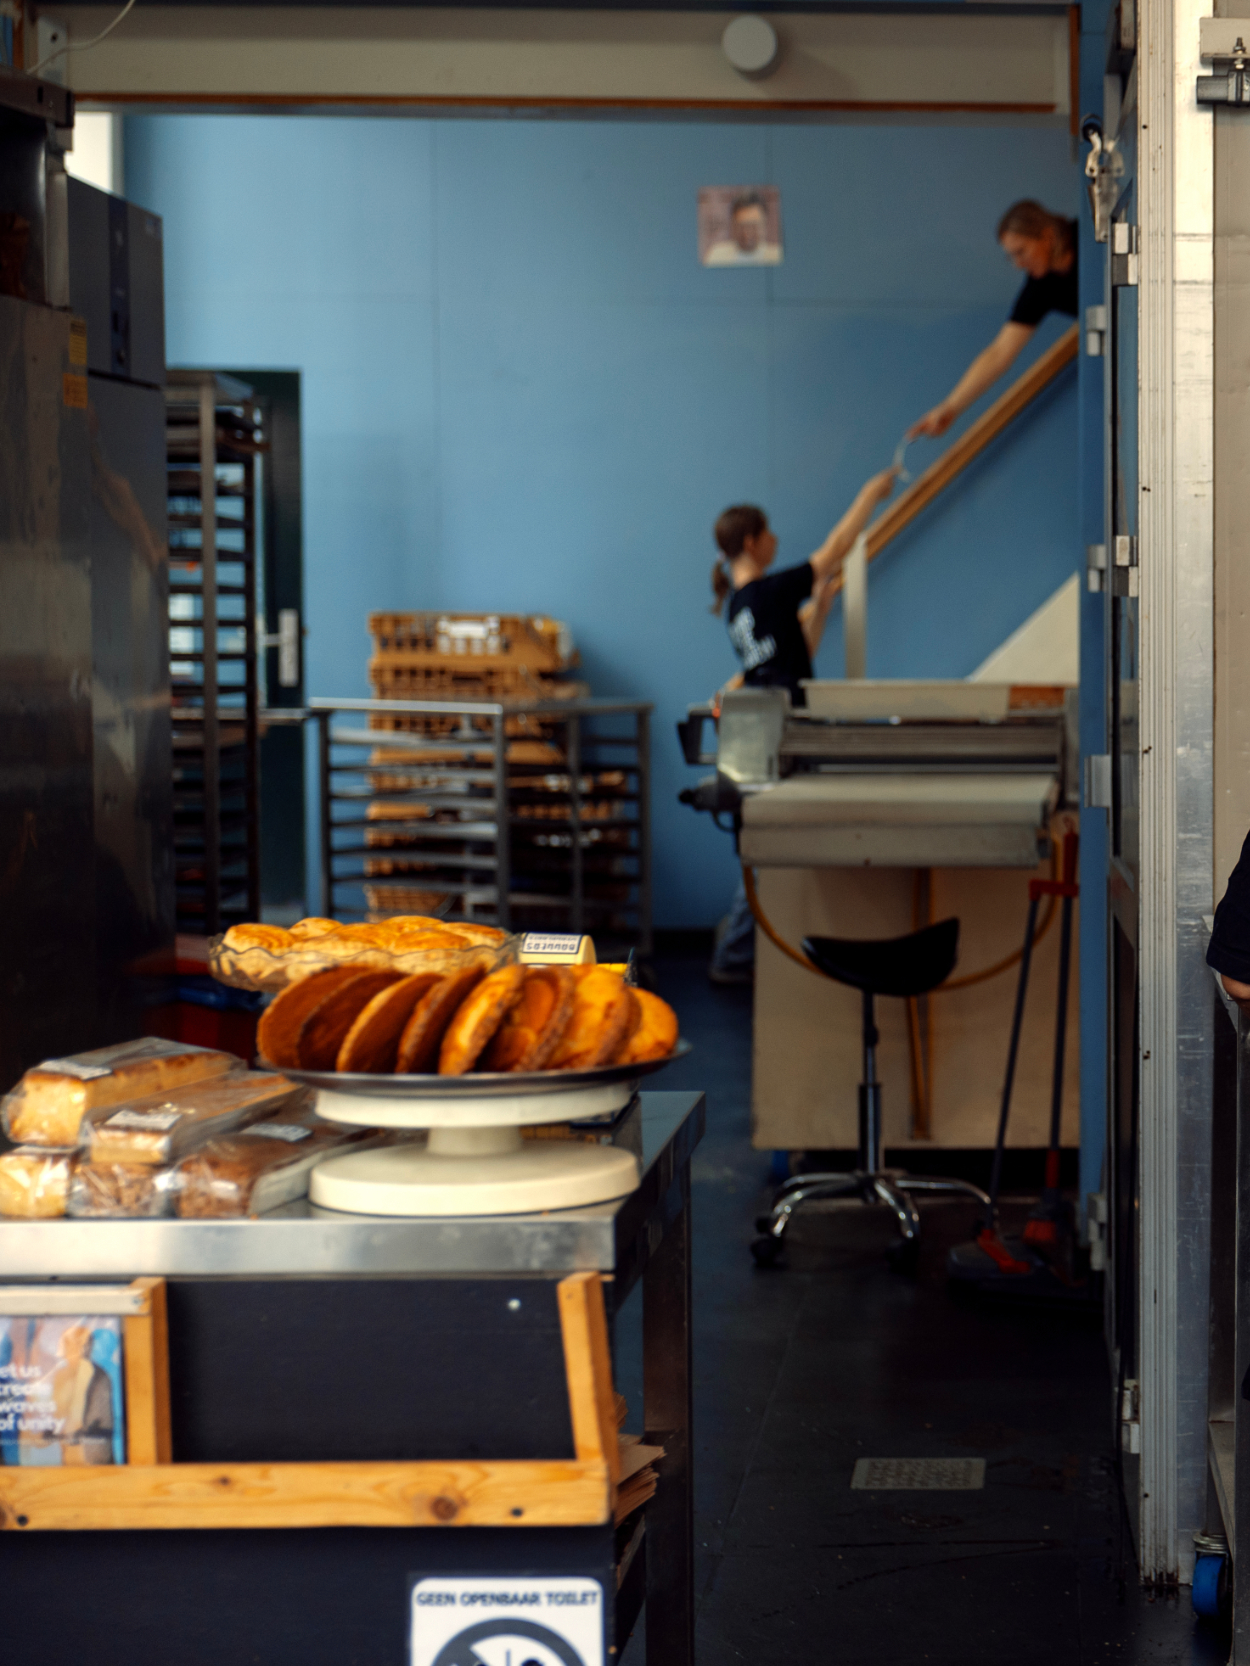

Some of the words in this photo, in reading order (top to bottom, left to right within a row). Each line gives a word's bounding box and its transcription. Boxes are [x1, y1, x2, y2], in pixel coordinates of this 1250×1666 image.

[17, 1414, 66, 1435] unity
[416, 1591, 457, 1606] GEEN
[460, 1591, 541, 1606] OPENBAAR
[545, 1590, 599, 1606] TOILET
